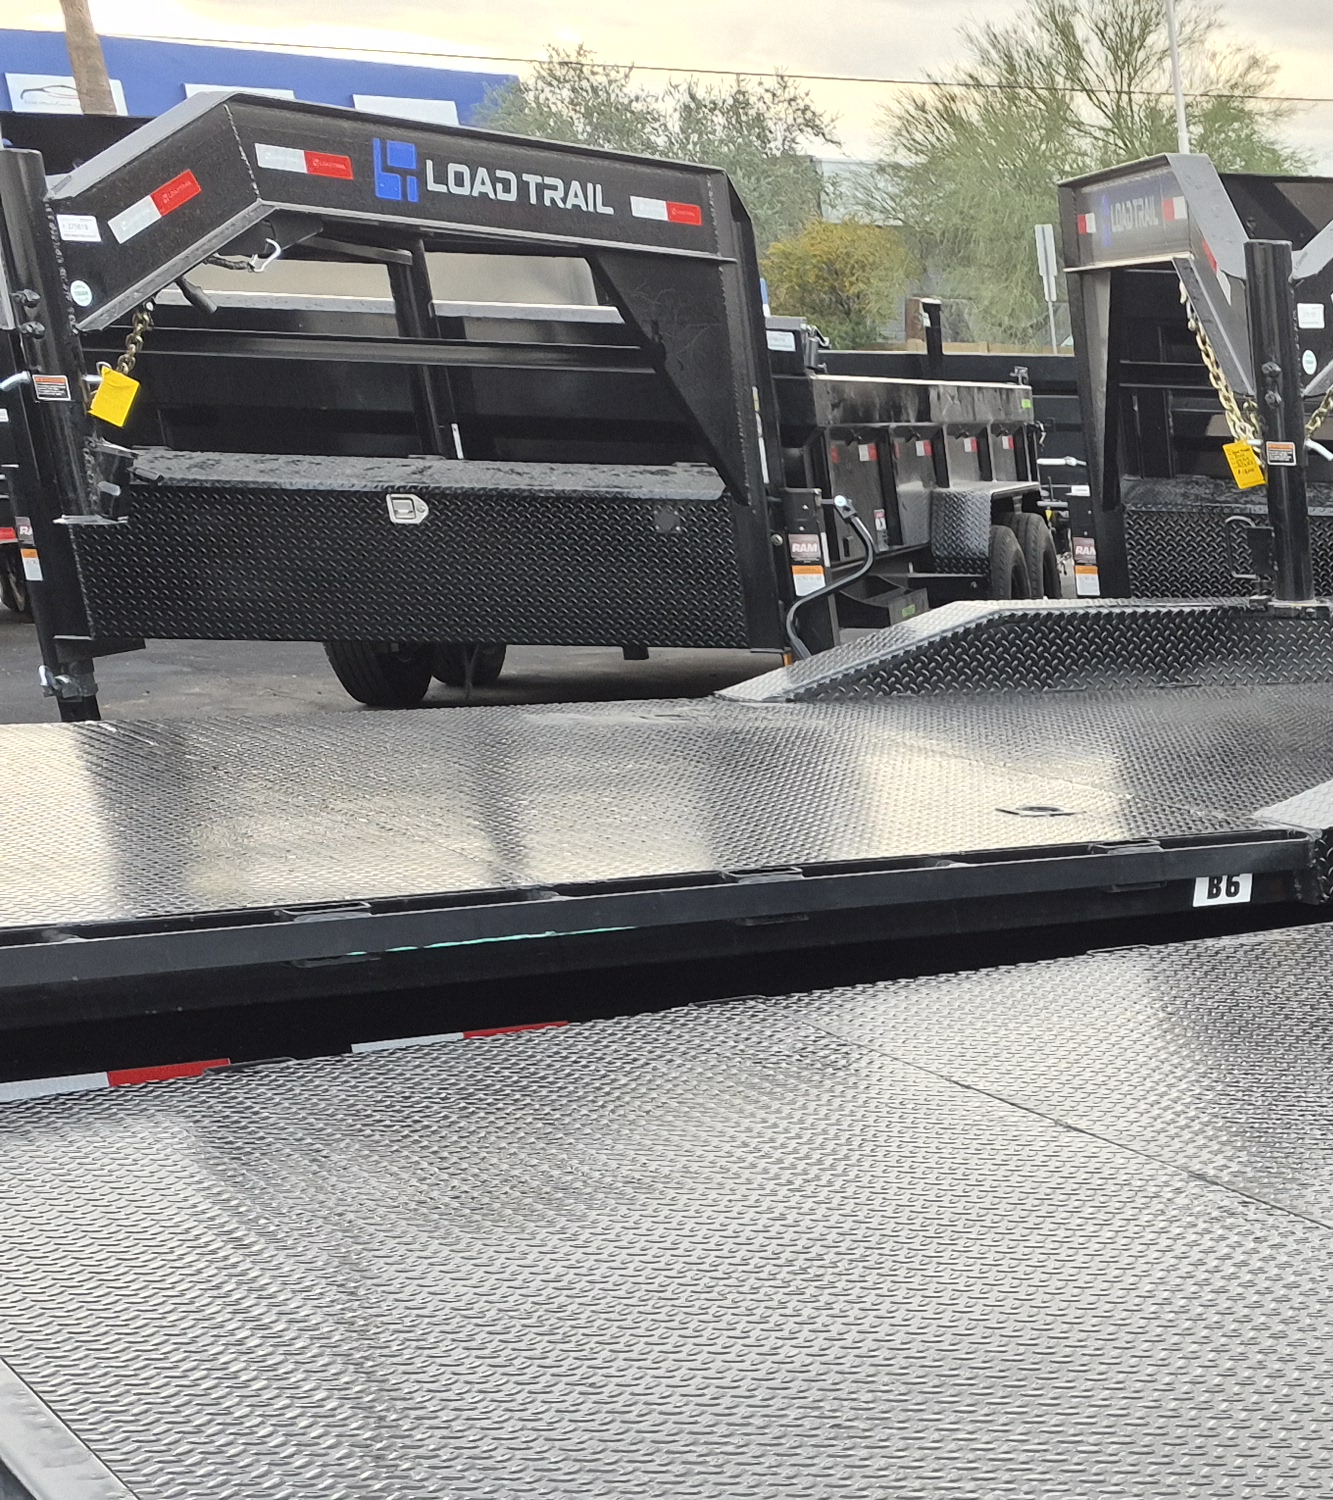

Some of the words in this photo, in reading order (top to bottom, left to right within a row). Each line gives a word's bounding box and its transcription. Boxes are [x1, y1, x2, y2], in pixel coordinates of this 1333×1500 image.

[426, 160, 517, 201] LOAD
[521, 174, 615, 215] TRAIL
[792, 542, 818, 553] RAM
[1207, 875, 1241, 899] B6
